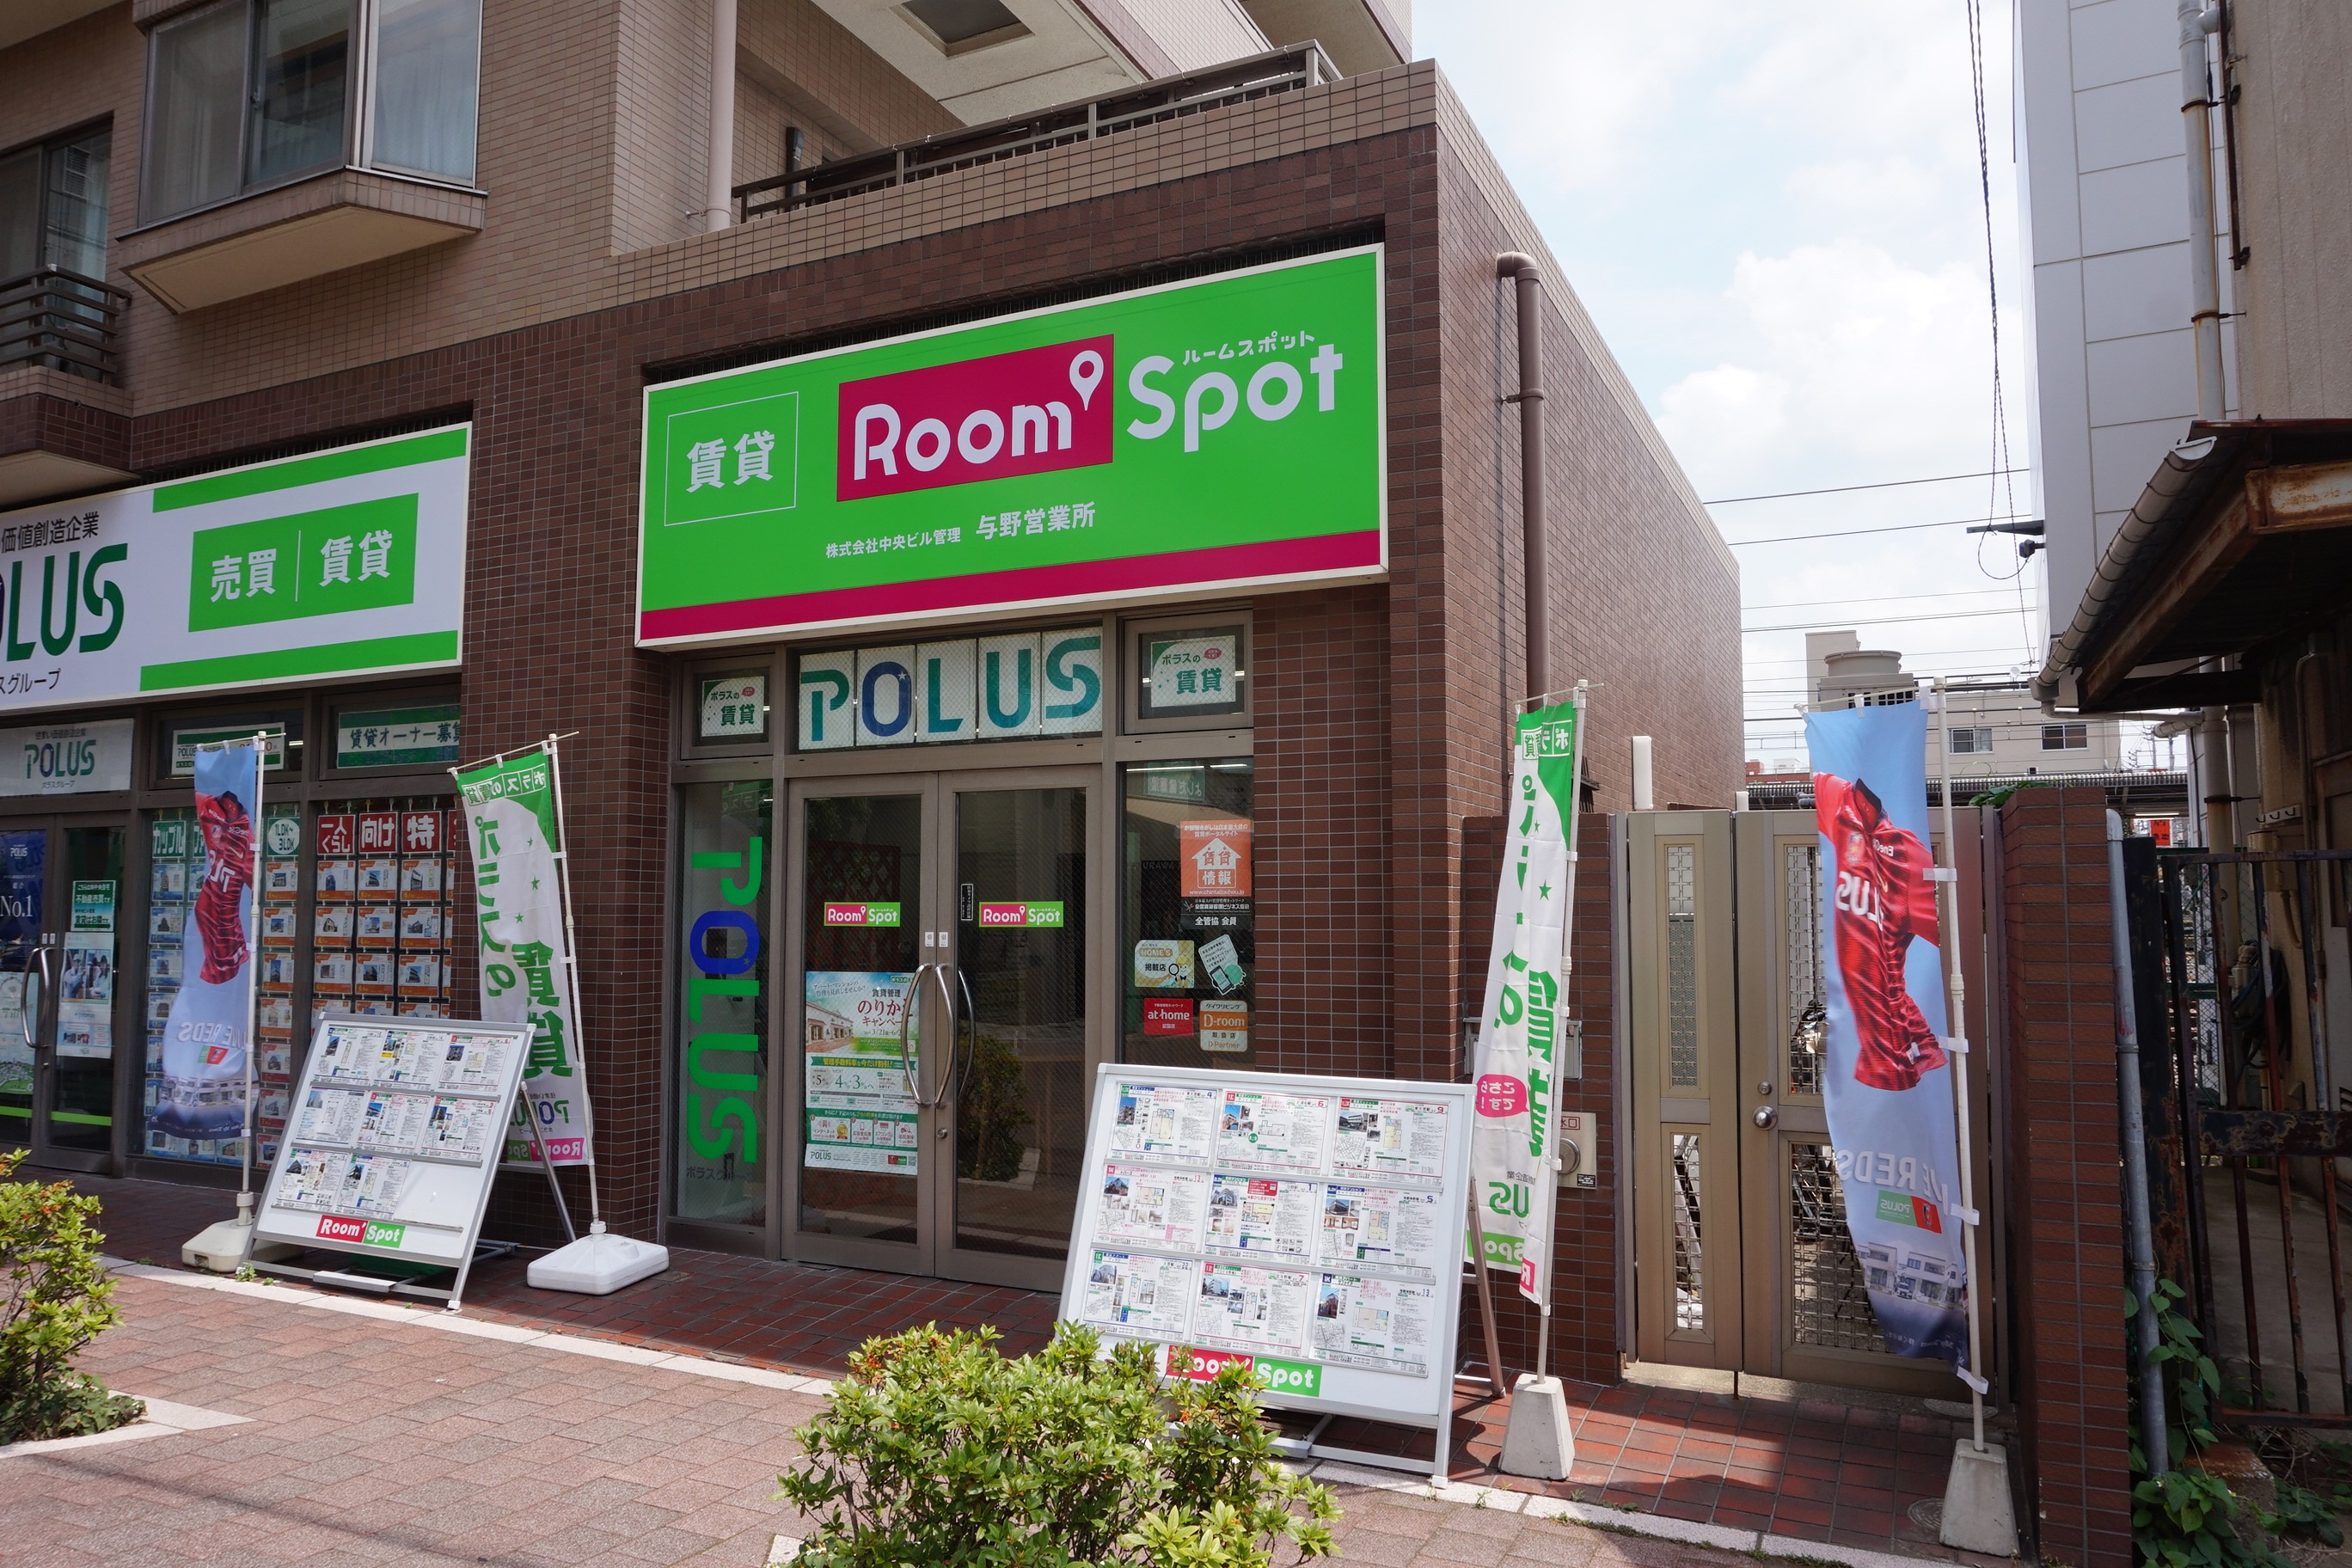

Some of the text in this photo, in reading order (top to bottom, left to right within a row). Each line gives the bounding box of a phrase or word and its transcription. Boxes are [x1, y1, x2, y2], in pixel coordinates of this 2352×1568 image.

[1183, 330, 1314, 365] ルームスポット
[1127, 344, 1343, 452] Spot
[686, 431, 775, 493] 賃貸
[2, 511, 99, 553] 価値創造企業
[826, 501, 1095, 559] 株式会社中央ビル管理 与野営業所
[210, 529, 393, 603] 売買 賃貸
[0, 542, 128, 662] LUS
[1162, 653, 1201, 665] ポラスの
[800, 637, 1101, 742] POLUS
[1176, 668, 1222, 695] 賃貸
[711, 691, 739, 701] ポラスの
[721, 703, 755, 726] 賃貸
[24, 739, 96, 779] POLUS
[153, 825, 184, 854] カップル
[362, 818, 395, 848] 向け
[407, 815, 435, 849] 特
[1203, 847, 1231, 866] 賃貸
[1203, 871, 1231, 885] 情報
[0, 895, 33, 918] No.1
[869, 909, 897, 925] Spot
[1028, 909, 1060, 925] Spot
[1195, 916, 1237, 926] 全管協 会員
[688, 836, 763, 1163] POLUS
[872, 989, 901, 997] 賃貸管理
[862, 1016, 903, 1027] キャンペー
[1148, 1008, 1190, 1020] at home
[1204, 1014, 1245, 1027] D-room
[811, 1151, 832, 1160] POLUS
[366, 1225, 400, 1243] Spot
[1257, 1363, 1314, 1388] Spot
